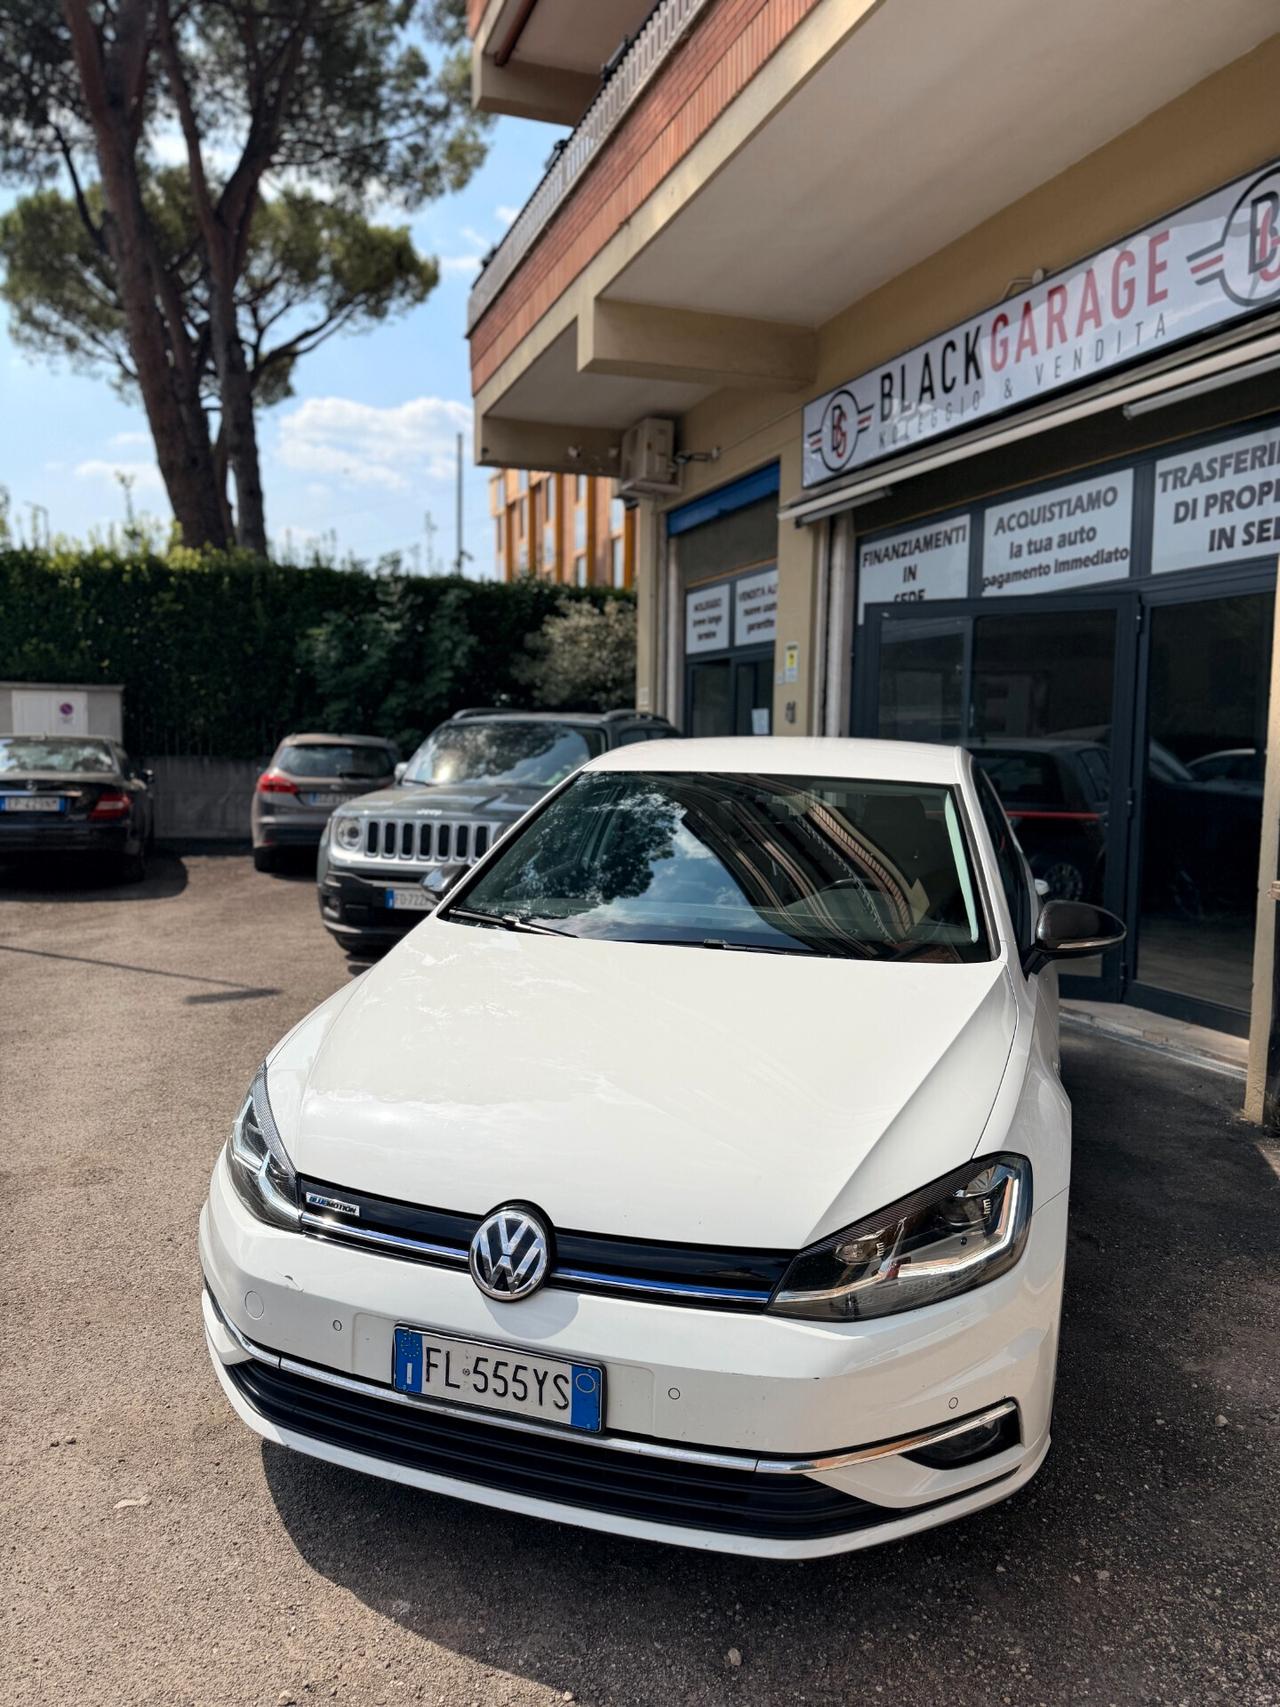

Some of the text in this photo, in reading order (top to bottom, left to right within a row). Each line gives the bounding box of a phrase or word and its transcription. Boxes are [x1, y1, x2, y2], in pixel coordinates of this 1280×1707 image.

[1004, 378, 1014, 398] &
[1035, 313, 1167, 385] VENDITA
[1158, 440, 1280, 494] TRASFERI
[994, 486, 1119, 537] ACQUISTIAMO
[1173, 497, 1198, 525] DI
[862, 524, 968, 568] FINANZIAMENTI
[1009, 525, 1097, 560] la tua auto
[1208, 525, 1236, 552] IN
[903, 564, 917, 584] IN
[981, 563, 1051, 592] pagamento
